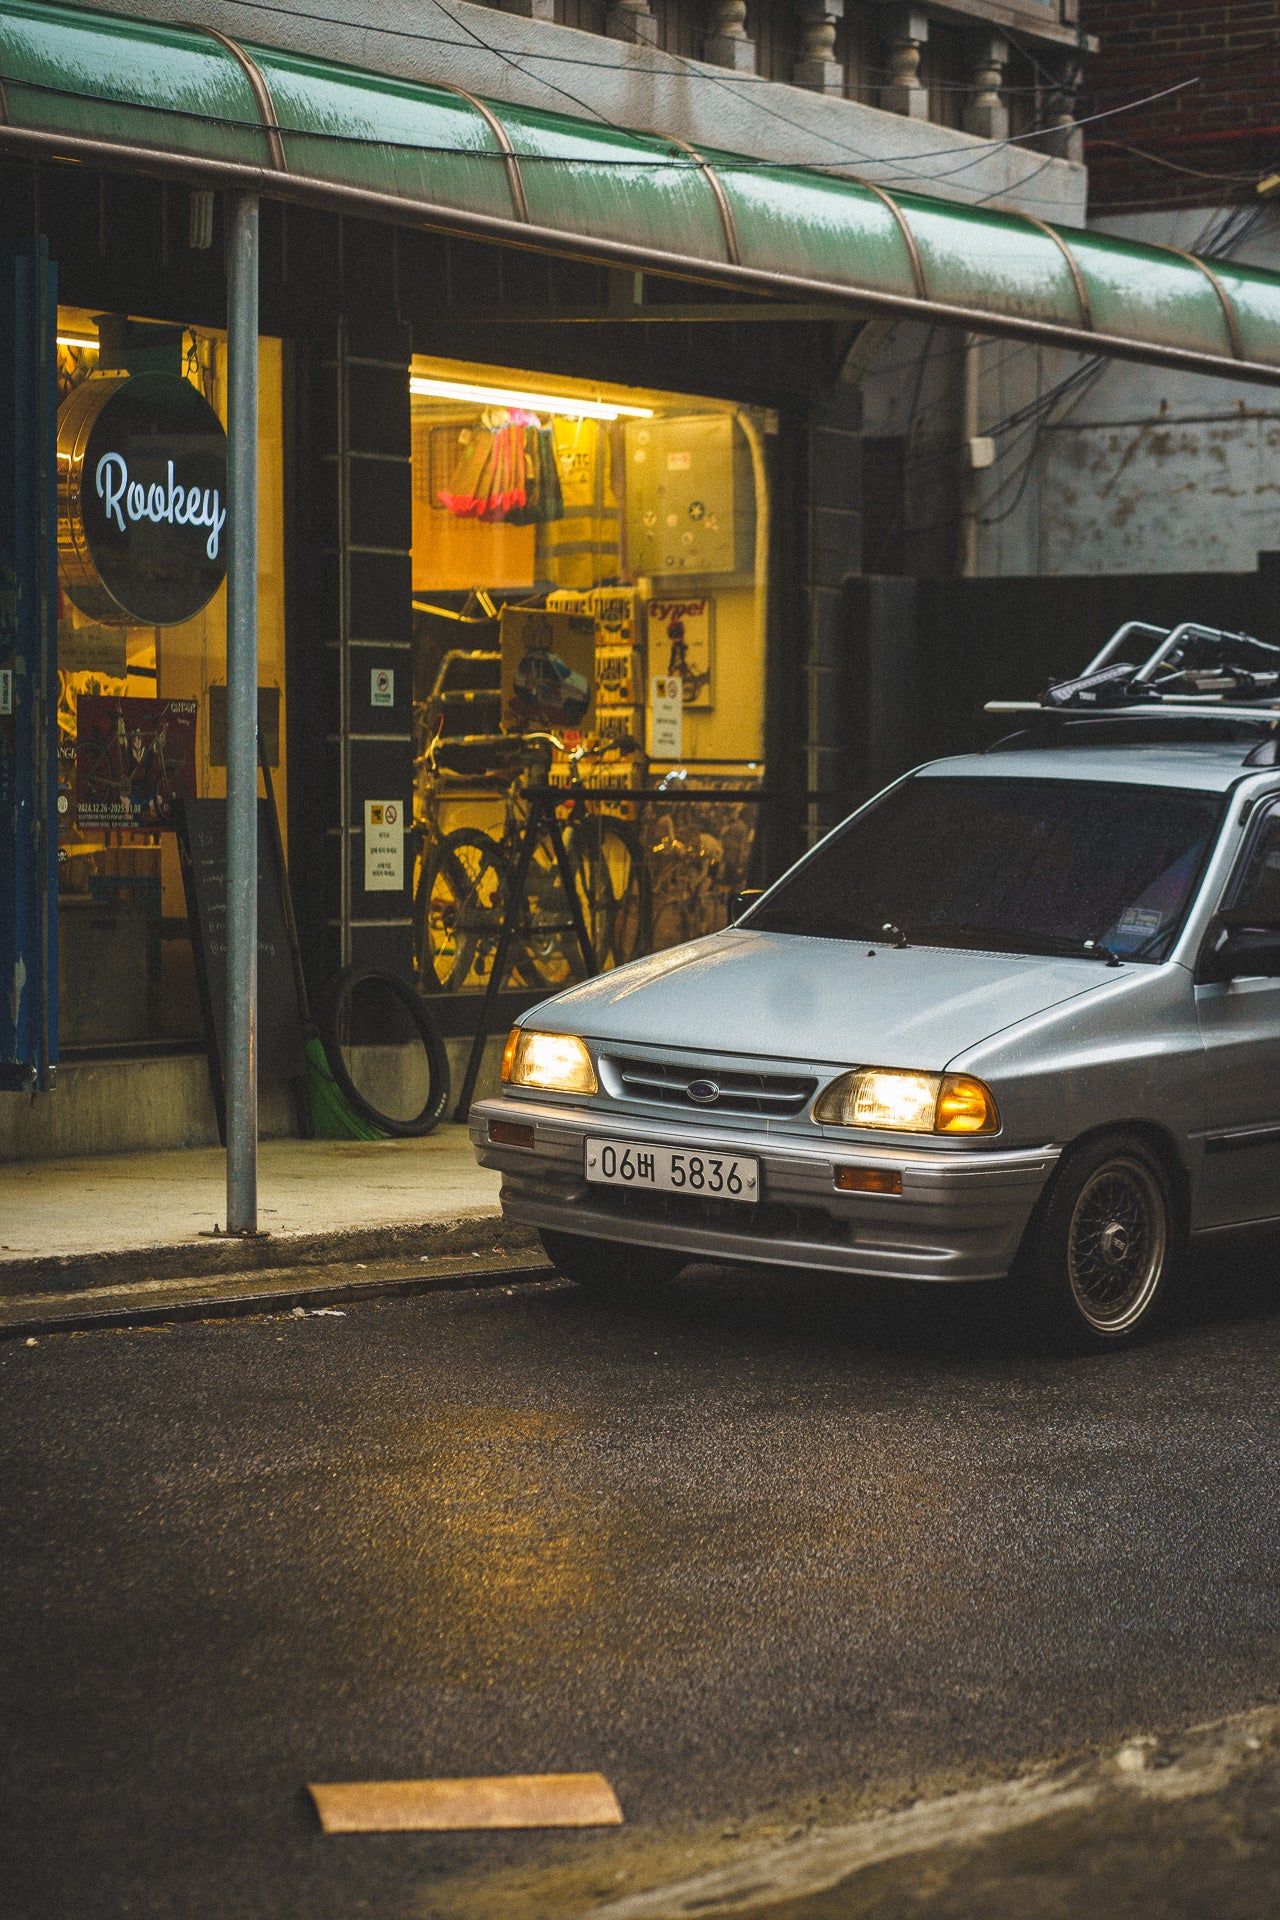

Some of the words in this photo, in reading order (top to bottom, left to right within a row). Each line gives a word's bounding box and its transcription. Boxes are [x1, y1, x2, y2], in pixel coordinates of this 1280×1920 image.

[96, 452, 226, 560] Rookey
[601, 1145, 656, 1183] 06버
[670, 1154, 744, 1195] 5836
